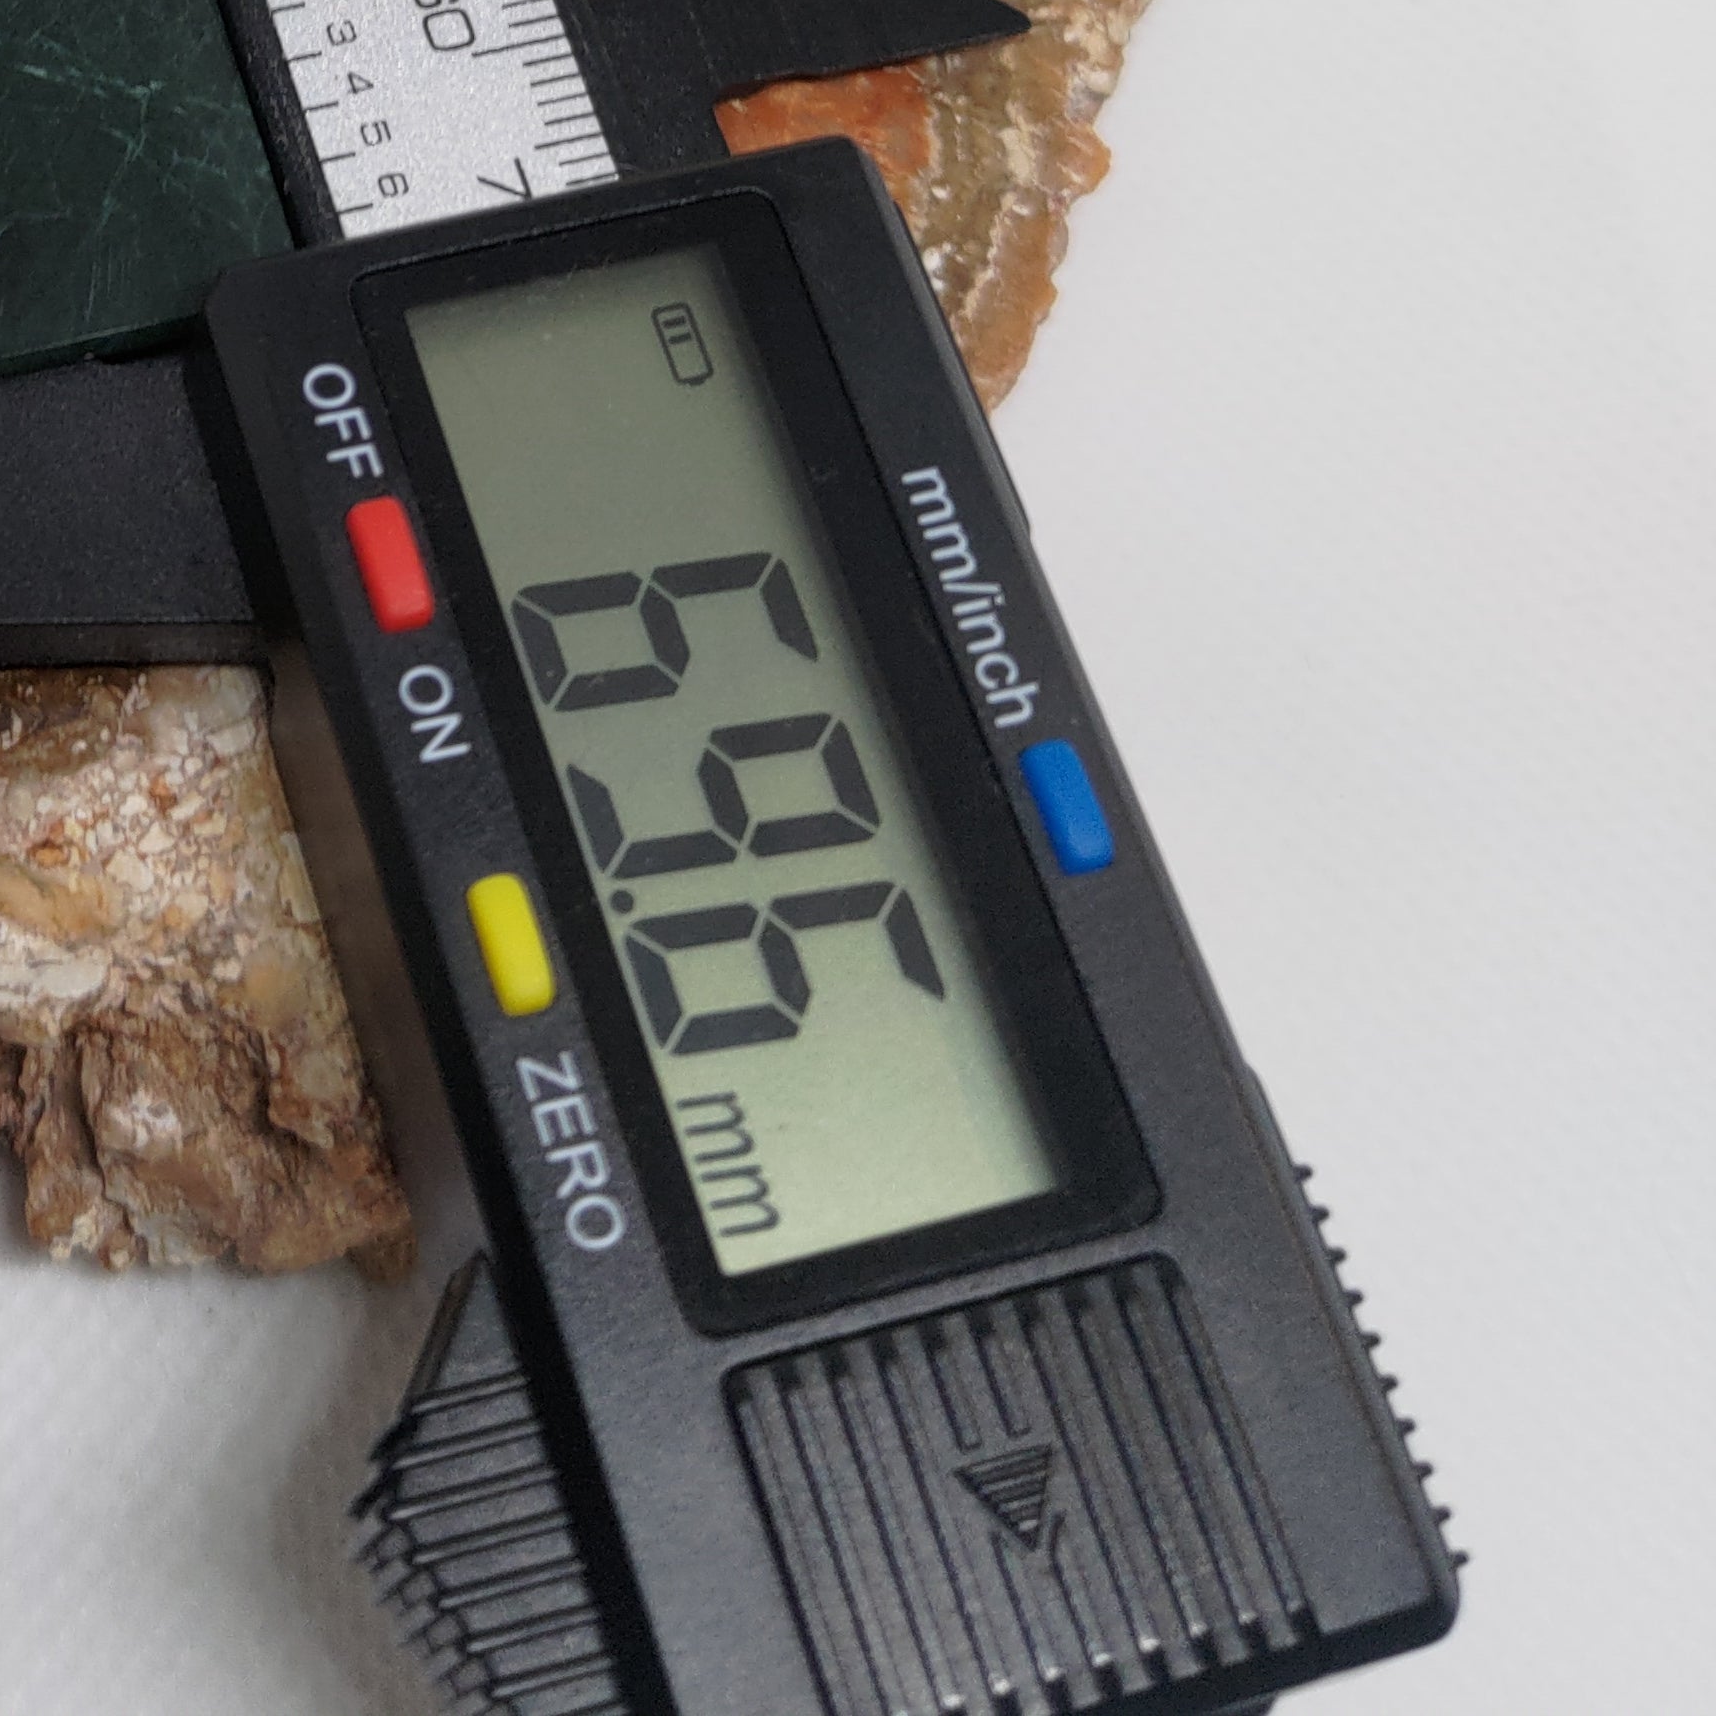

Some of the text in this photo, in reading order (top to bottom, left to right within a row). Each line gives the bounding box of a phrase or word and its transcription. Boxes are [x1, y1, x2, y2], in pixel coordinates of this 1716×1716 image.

[326, 20, 357, 47] 3
[346, 71, 375, 96] 4
[360, 120, 392, 146] 5
[378, 172, 410, 198] 6
[302, 362, 384, 481] OFF
[900, 466, 1041, 729] mm/inch
[397, 663, 472, 763] ON
[508, 550, 948, 1238] 69.6 mm
[514, 1050, 626, 1251] ZERO
